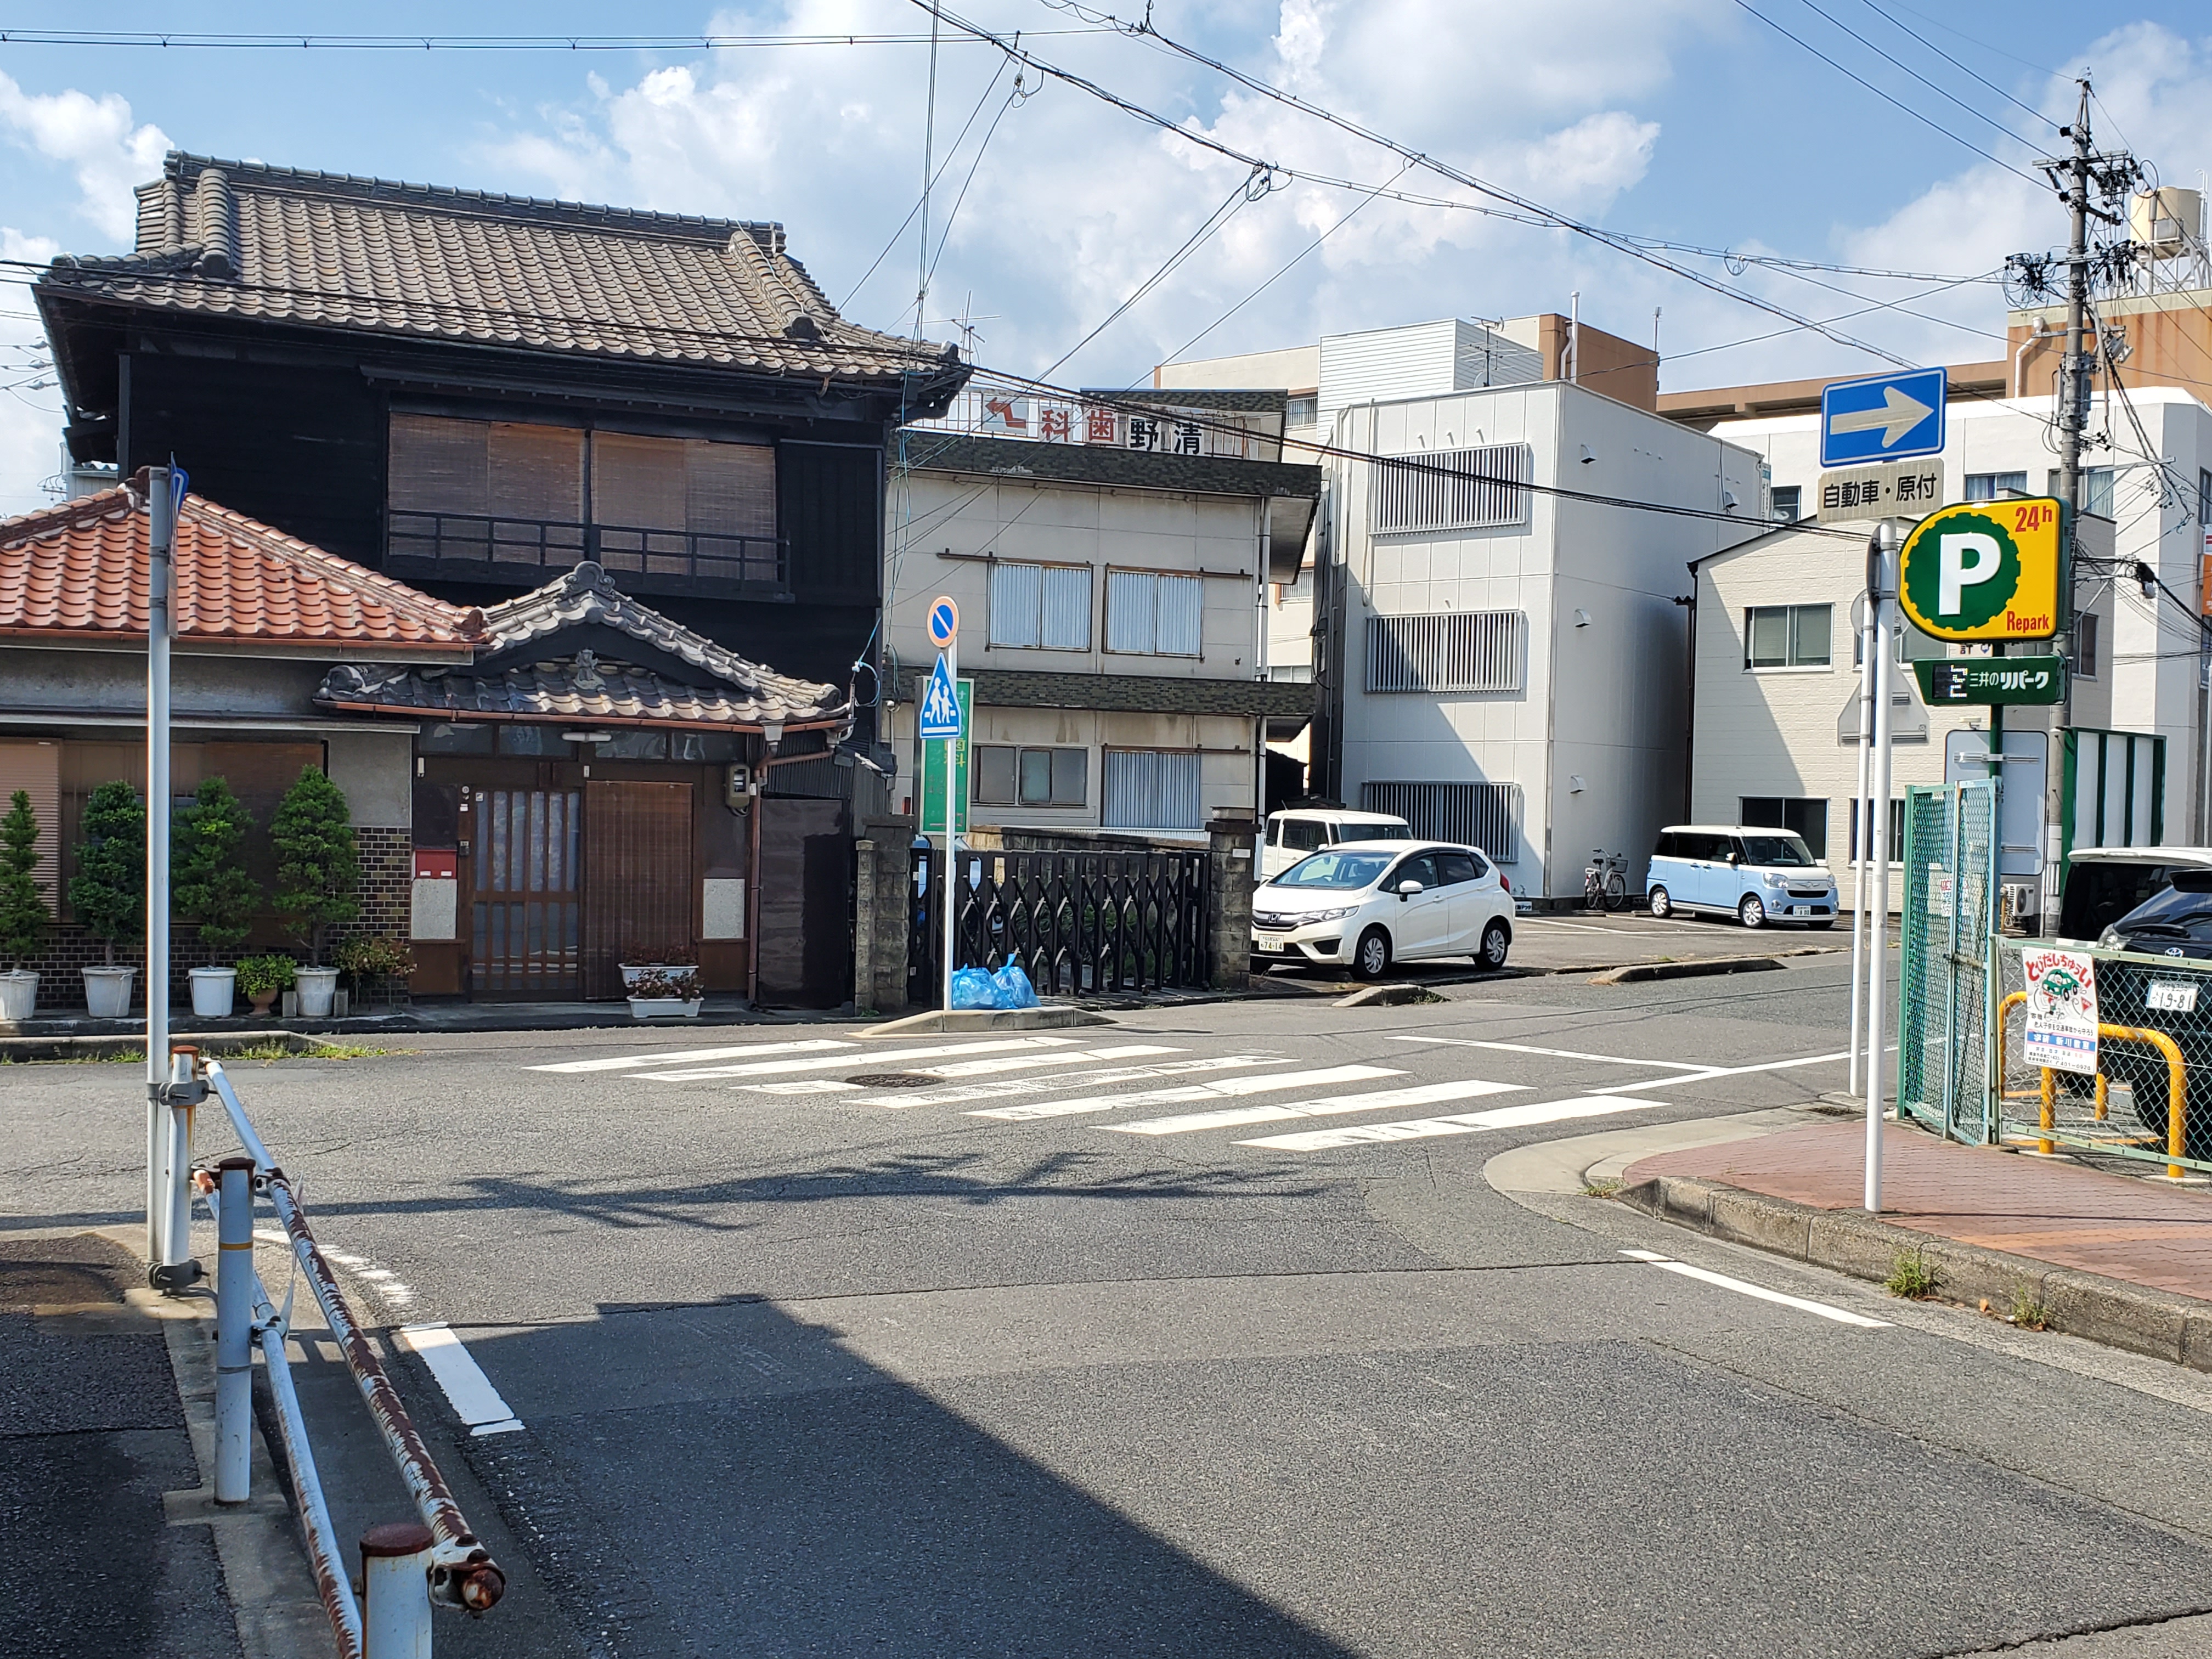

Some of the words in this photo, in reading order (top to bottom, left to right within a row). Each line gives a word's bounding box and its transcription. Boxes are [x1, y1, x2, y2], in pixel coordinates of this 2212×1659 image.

[1823, 472, 1937, 509] 自動車・原付
[2015, 505, 2052, 533] 24h
[1938, 532, 2001, 616] P
[2006, 610, 2050, 633] Repark
[1969, 669, 2049, 690] 三井のリパーク
[2025, 952, 2092, 989] とびだしちゅうい
